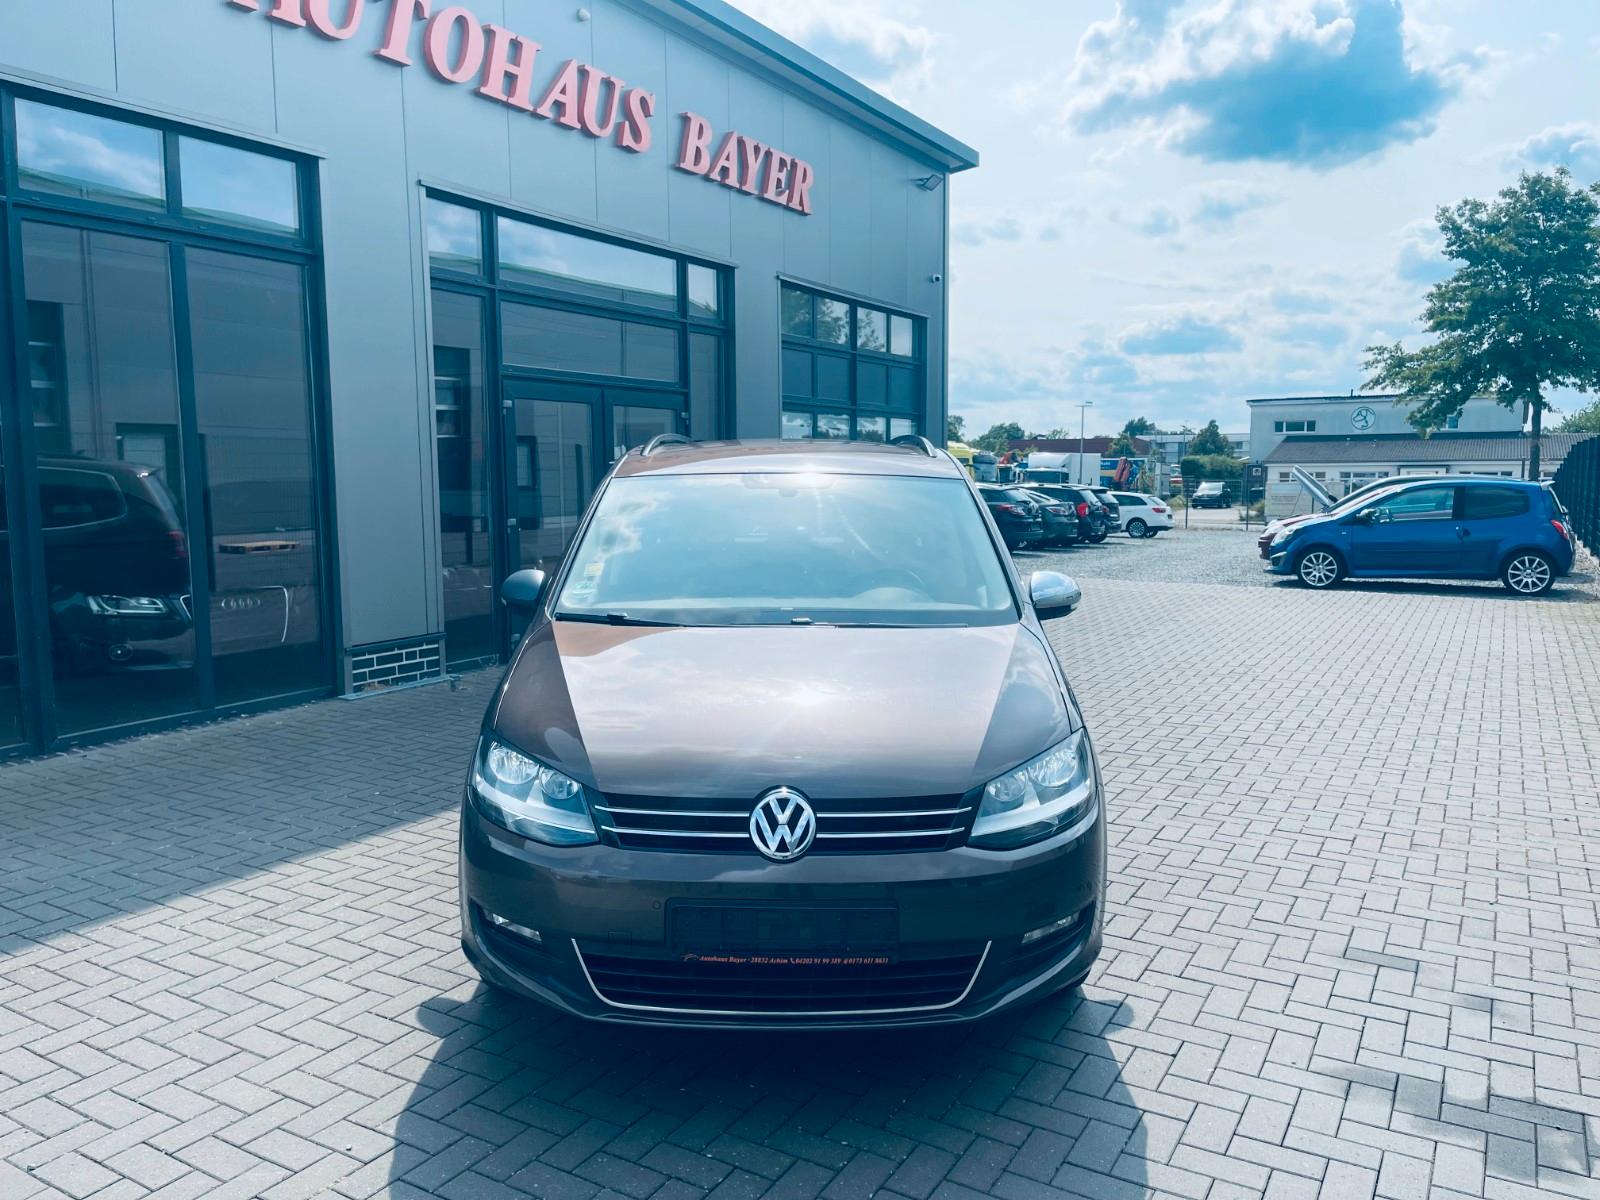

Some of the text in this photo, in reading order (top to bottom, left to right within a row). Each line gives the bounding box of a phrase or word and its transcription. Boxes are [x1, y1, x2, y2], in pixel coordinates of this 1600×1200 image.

[228, 0, 814, 215] UTOHAUS BAYER
[728, 956, 747, 964] Bayer
